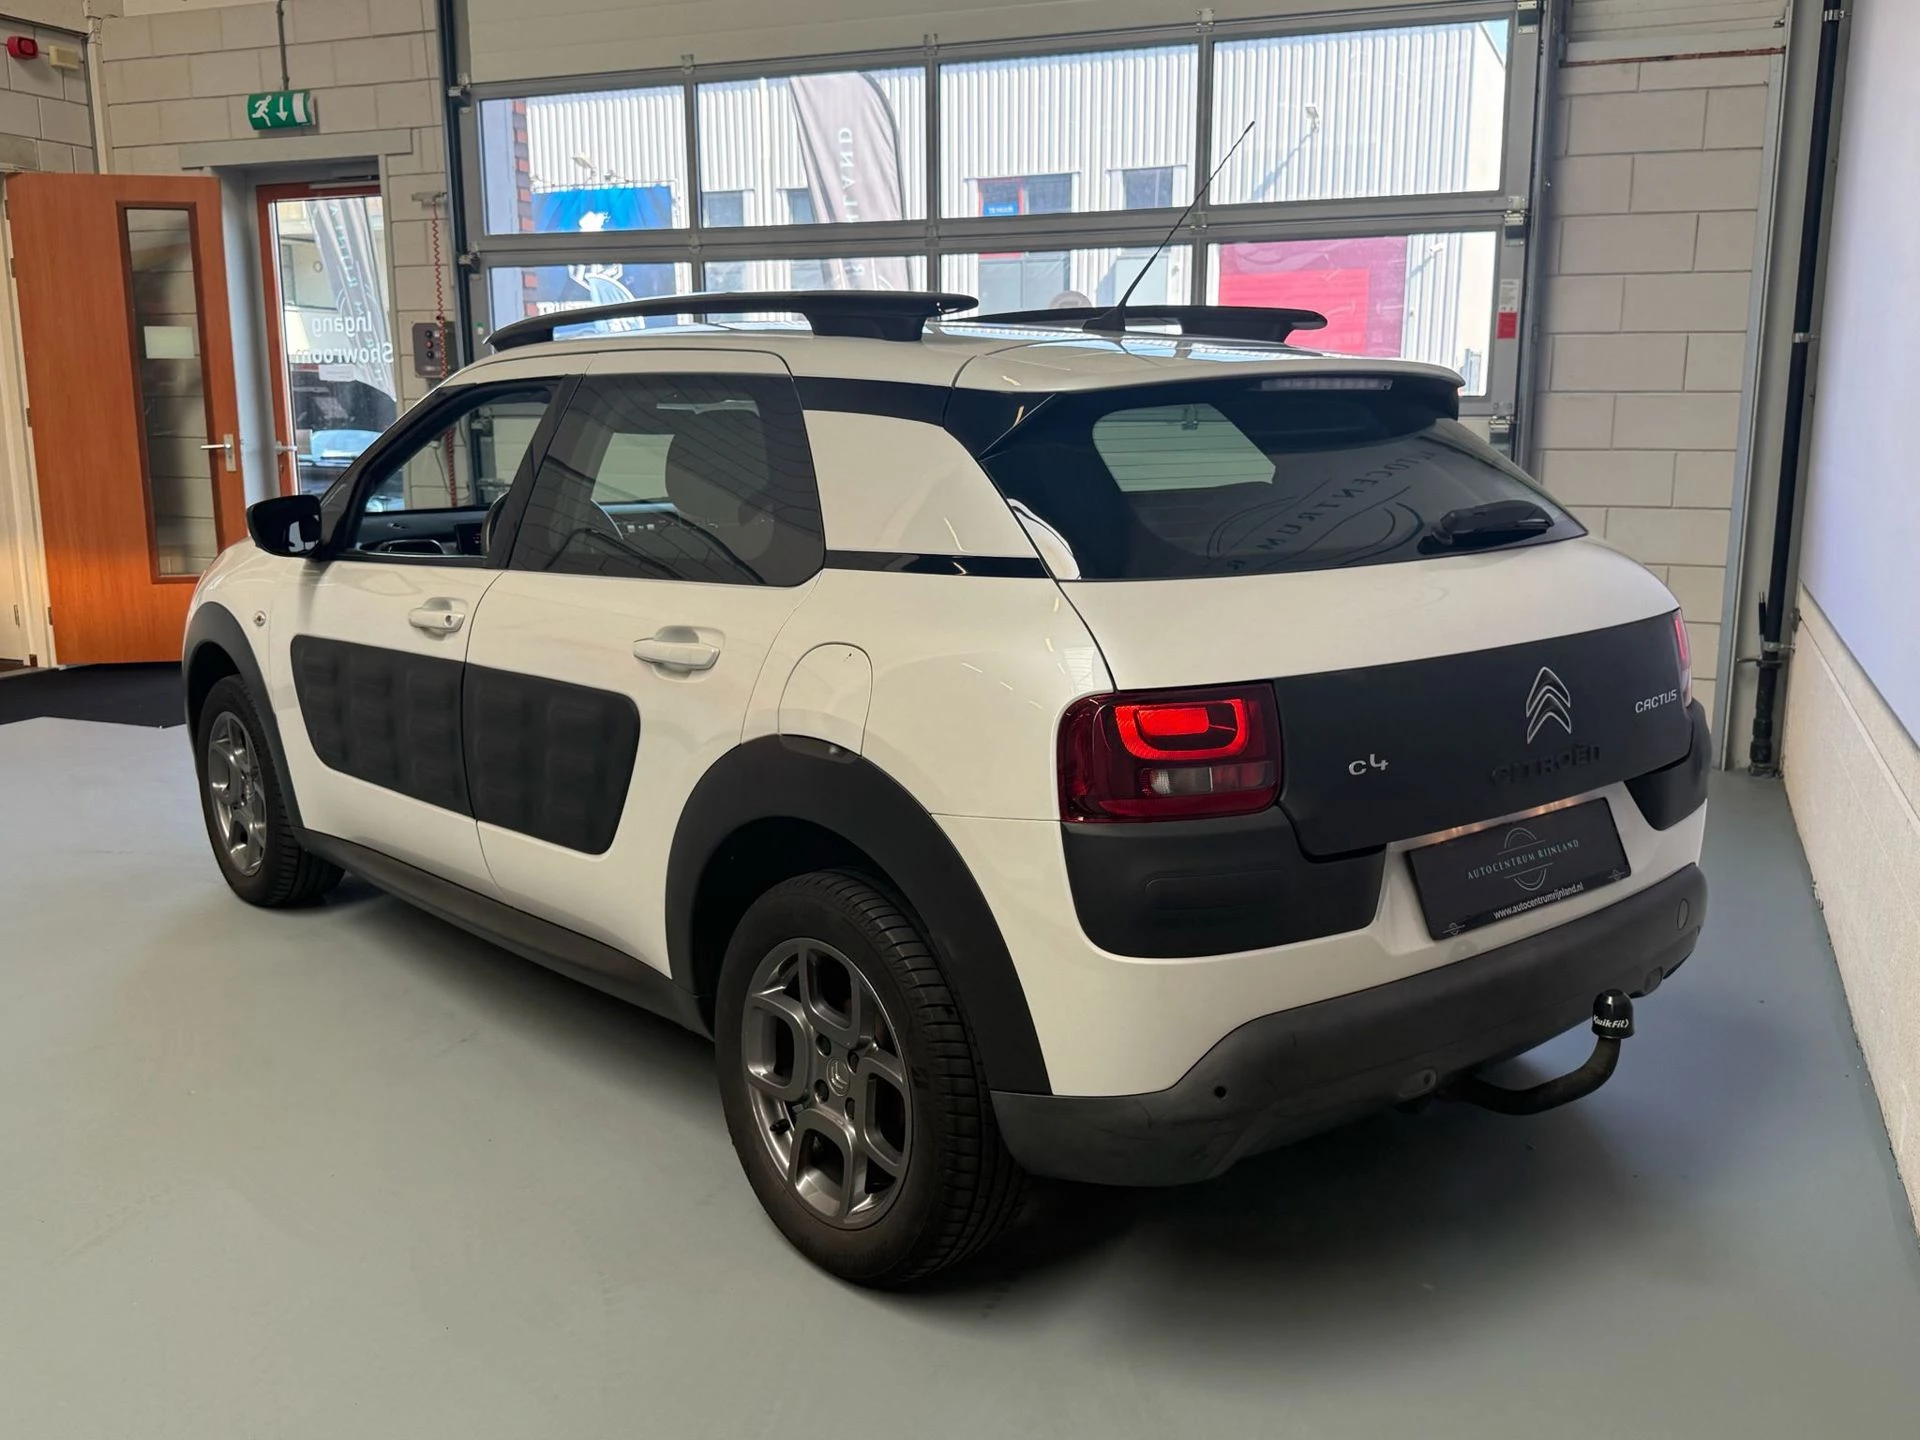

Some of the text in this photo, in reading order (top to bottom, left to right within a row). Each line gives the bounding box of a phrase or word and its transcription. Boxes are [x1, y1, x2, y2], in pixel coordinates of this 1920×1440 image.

[1635, 689, 1677, 714] CACTUS
[1349, 753, 1389, 775] C4
[1467, 839, 1579, 880] AUTOCENTRUM RIJNLAND
[1493, 881, 1585, 920] www.autocentrumrijnland.nl
